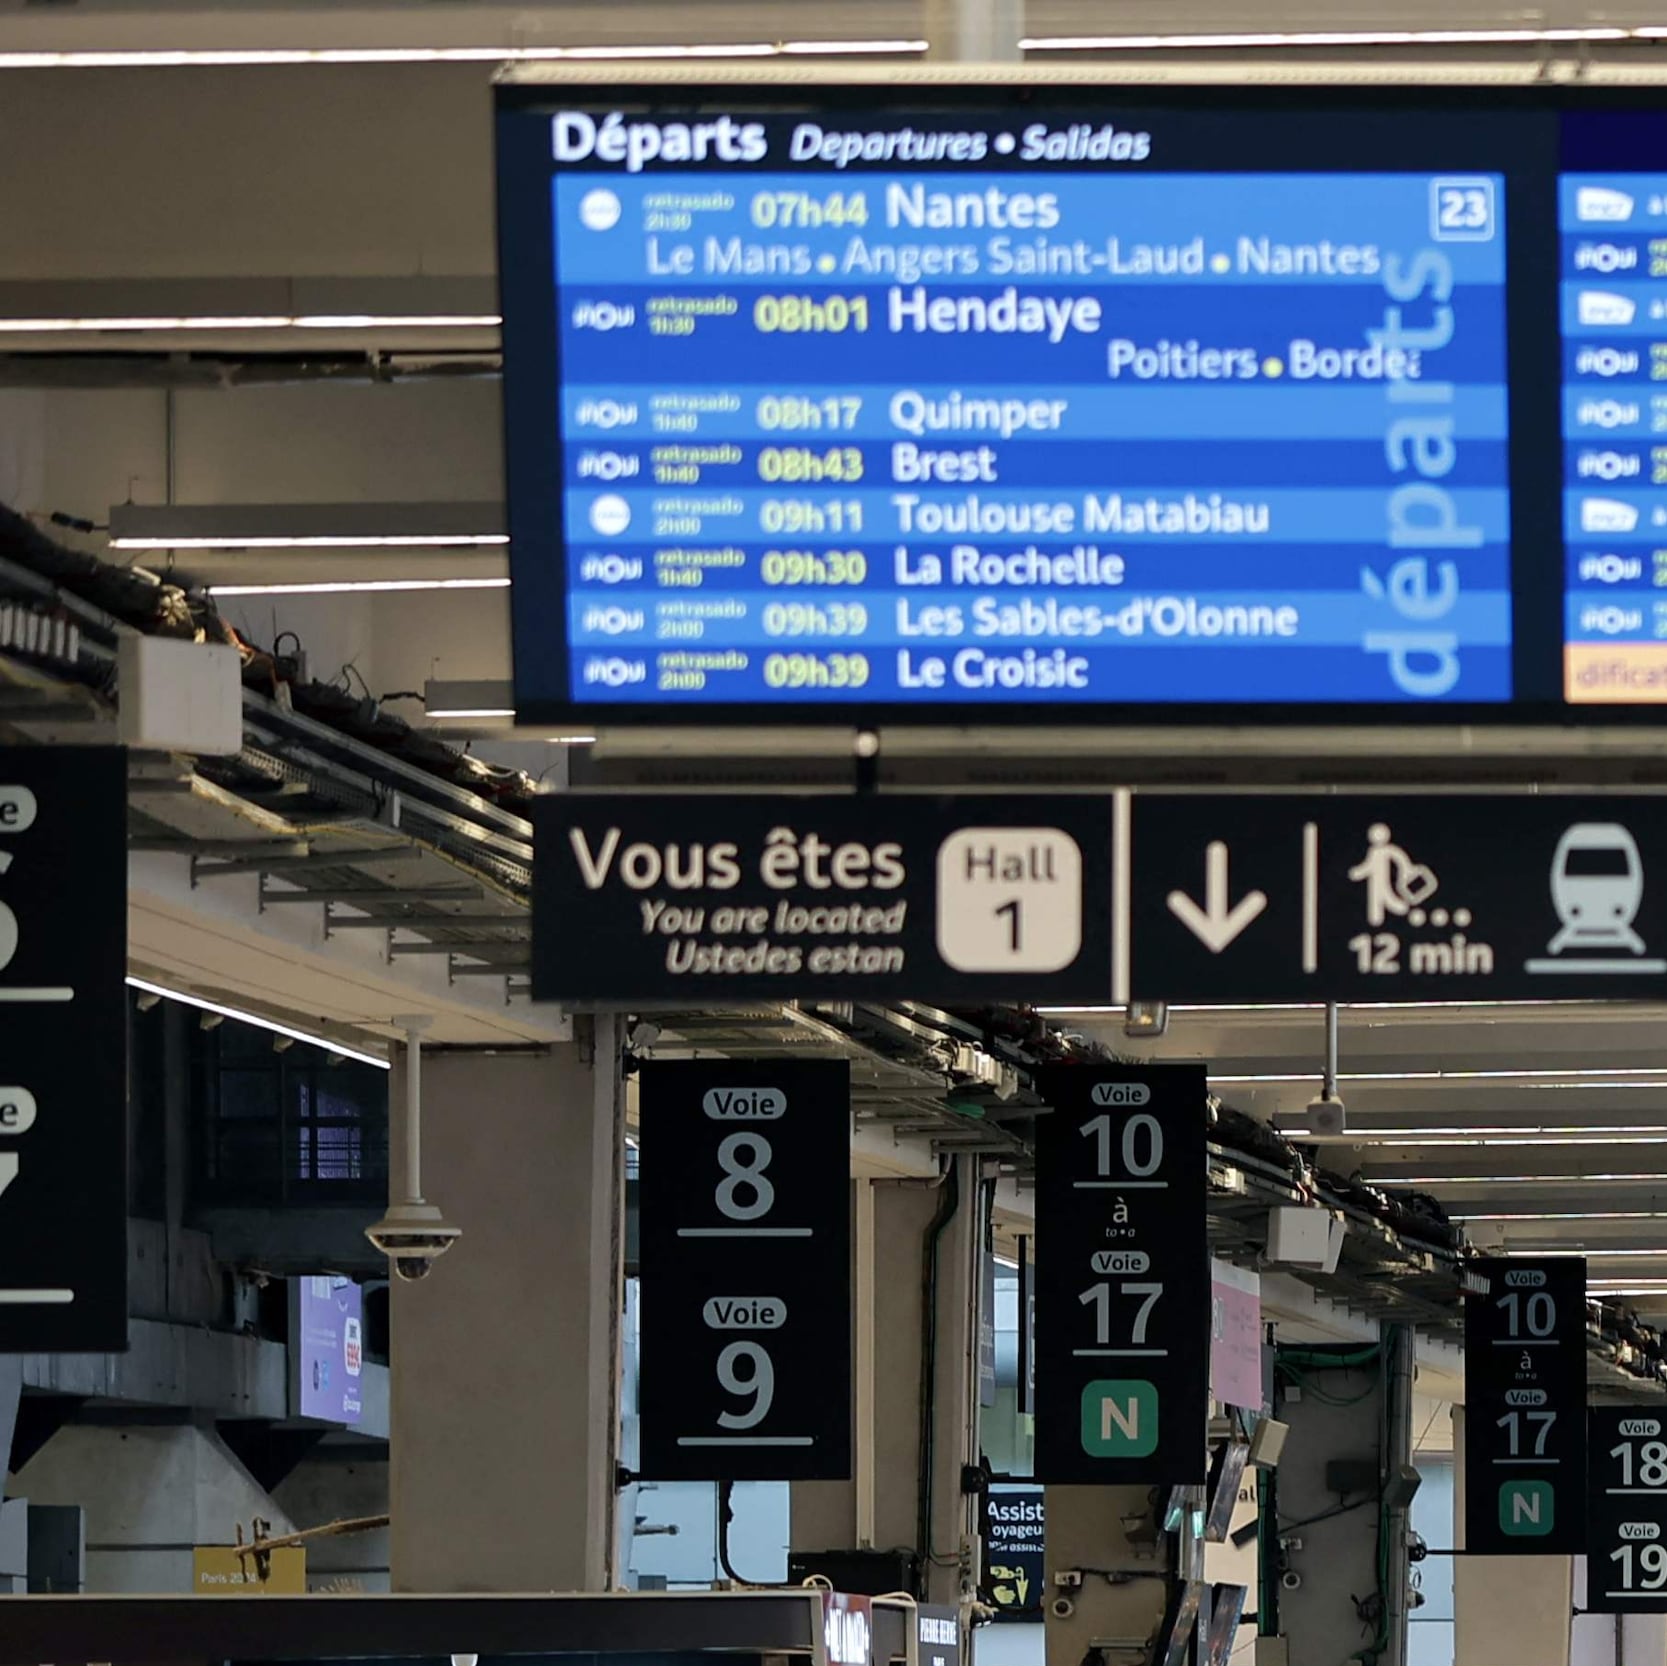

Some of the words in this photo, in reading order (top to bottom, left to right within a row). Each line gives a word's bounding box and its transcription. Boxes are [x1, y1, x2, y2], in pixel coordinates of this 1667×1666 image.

[552, 111, 767, 171] Départs
[790, 124, 986, 168] Departures
[1020, 124, 1151, 161] Salidas
[751, 191, 869, 228] 07h44
[886, 183, 1060, 228] Nantes
[1440, 190, 1488, 227] 23
[647, 237, 694, 275] Le
[703, 237, 811, 275] Mans
[842, 237, 979, 284] Angers
[988, 235, 1203, 275] Saint-Laud
[1238, 236, 1380, 275] Nantes
[753, 295, 869, 333] 08h01
[888, 287, 1100, 343] Hendaye
[1108, 340, 1258, 379] Poitiers
[757, 395, 863, 431] 08h17
[890, 390, 1067, 439] Quimper
[757, 447, 864, 482] 08h43
[891, 442, 997, 482] Brest
[1365, 249, 1483, 694] départs
[759, 500, 864, 534] 09h11
[892, 494, 1075, 535] Toulouse
[1083, 494, 1268, 535] Matabiau
[897, 597, 964, 637] Les
[972, 595, 1297, 637] Sables-d'Olonne
[570, 827, 740, 889] Vous
[760, 827, 905, 889] êtes
[965, 846, 1055, 883] Hall
[640, 902, 708, 934] You
[714, 907, 768, 934] are
[774, 900, 906, 934] located
[994, 900, 1023, 953] 1
[666, 940, 802, 974] Ustedes
[1350, 937, 1399, 972] 12
[1412, 935, 1492, 972] min
[713, 1092, 775, 1117] Voie
[1099, 1085, 1142, 1102] Voie
[1078, 1113, 1163, 1177] 10
[715, 1132, 775, 1221] 8
[713, 1301, 775, 1326] Voie
[1078, 1282, 1163, 1344] 17
[1496, 1292, 1556, 1337] 10
[716, 1341, 774, 1430] 9
[1101, 1397, 1139, 1440] N
[1497, 1411, 1557, 1456] 17
[1624, 1421, 1654, 1435] Voie
[1513, 1492, 1539, 1524] N
